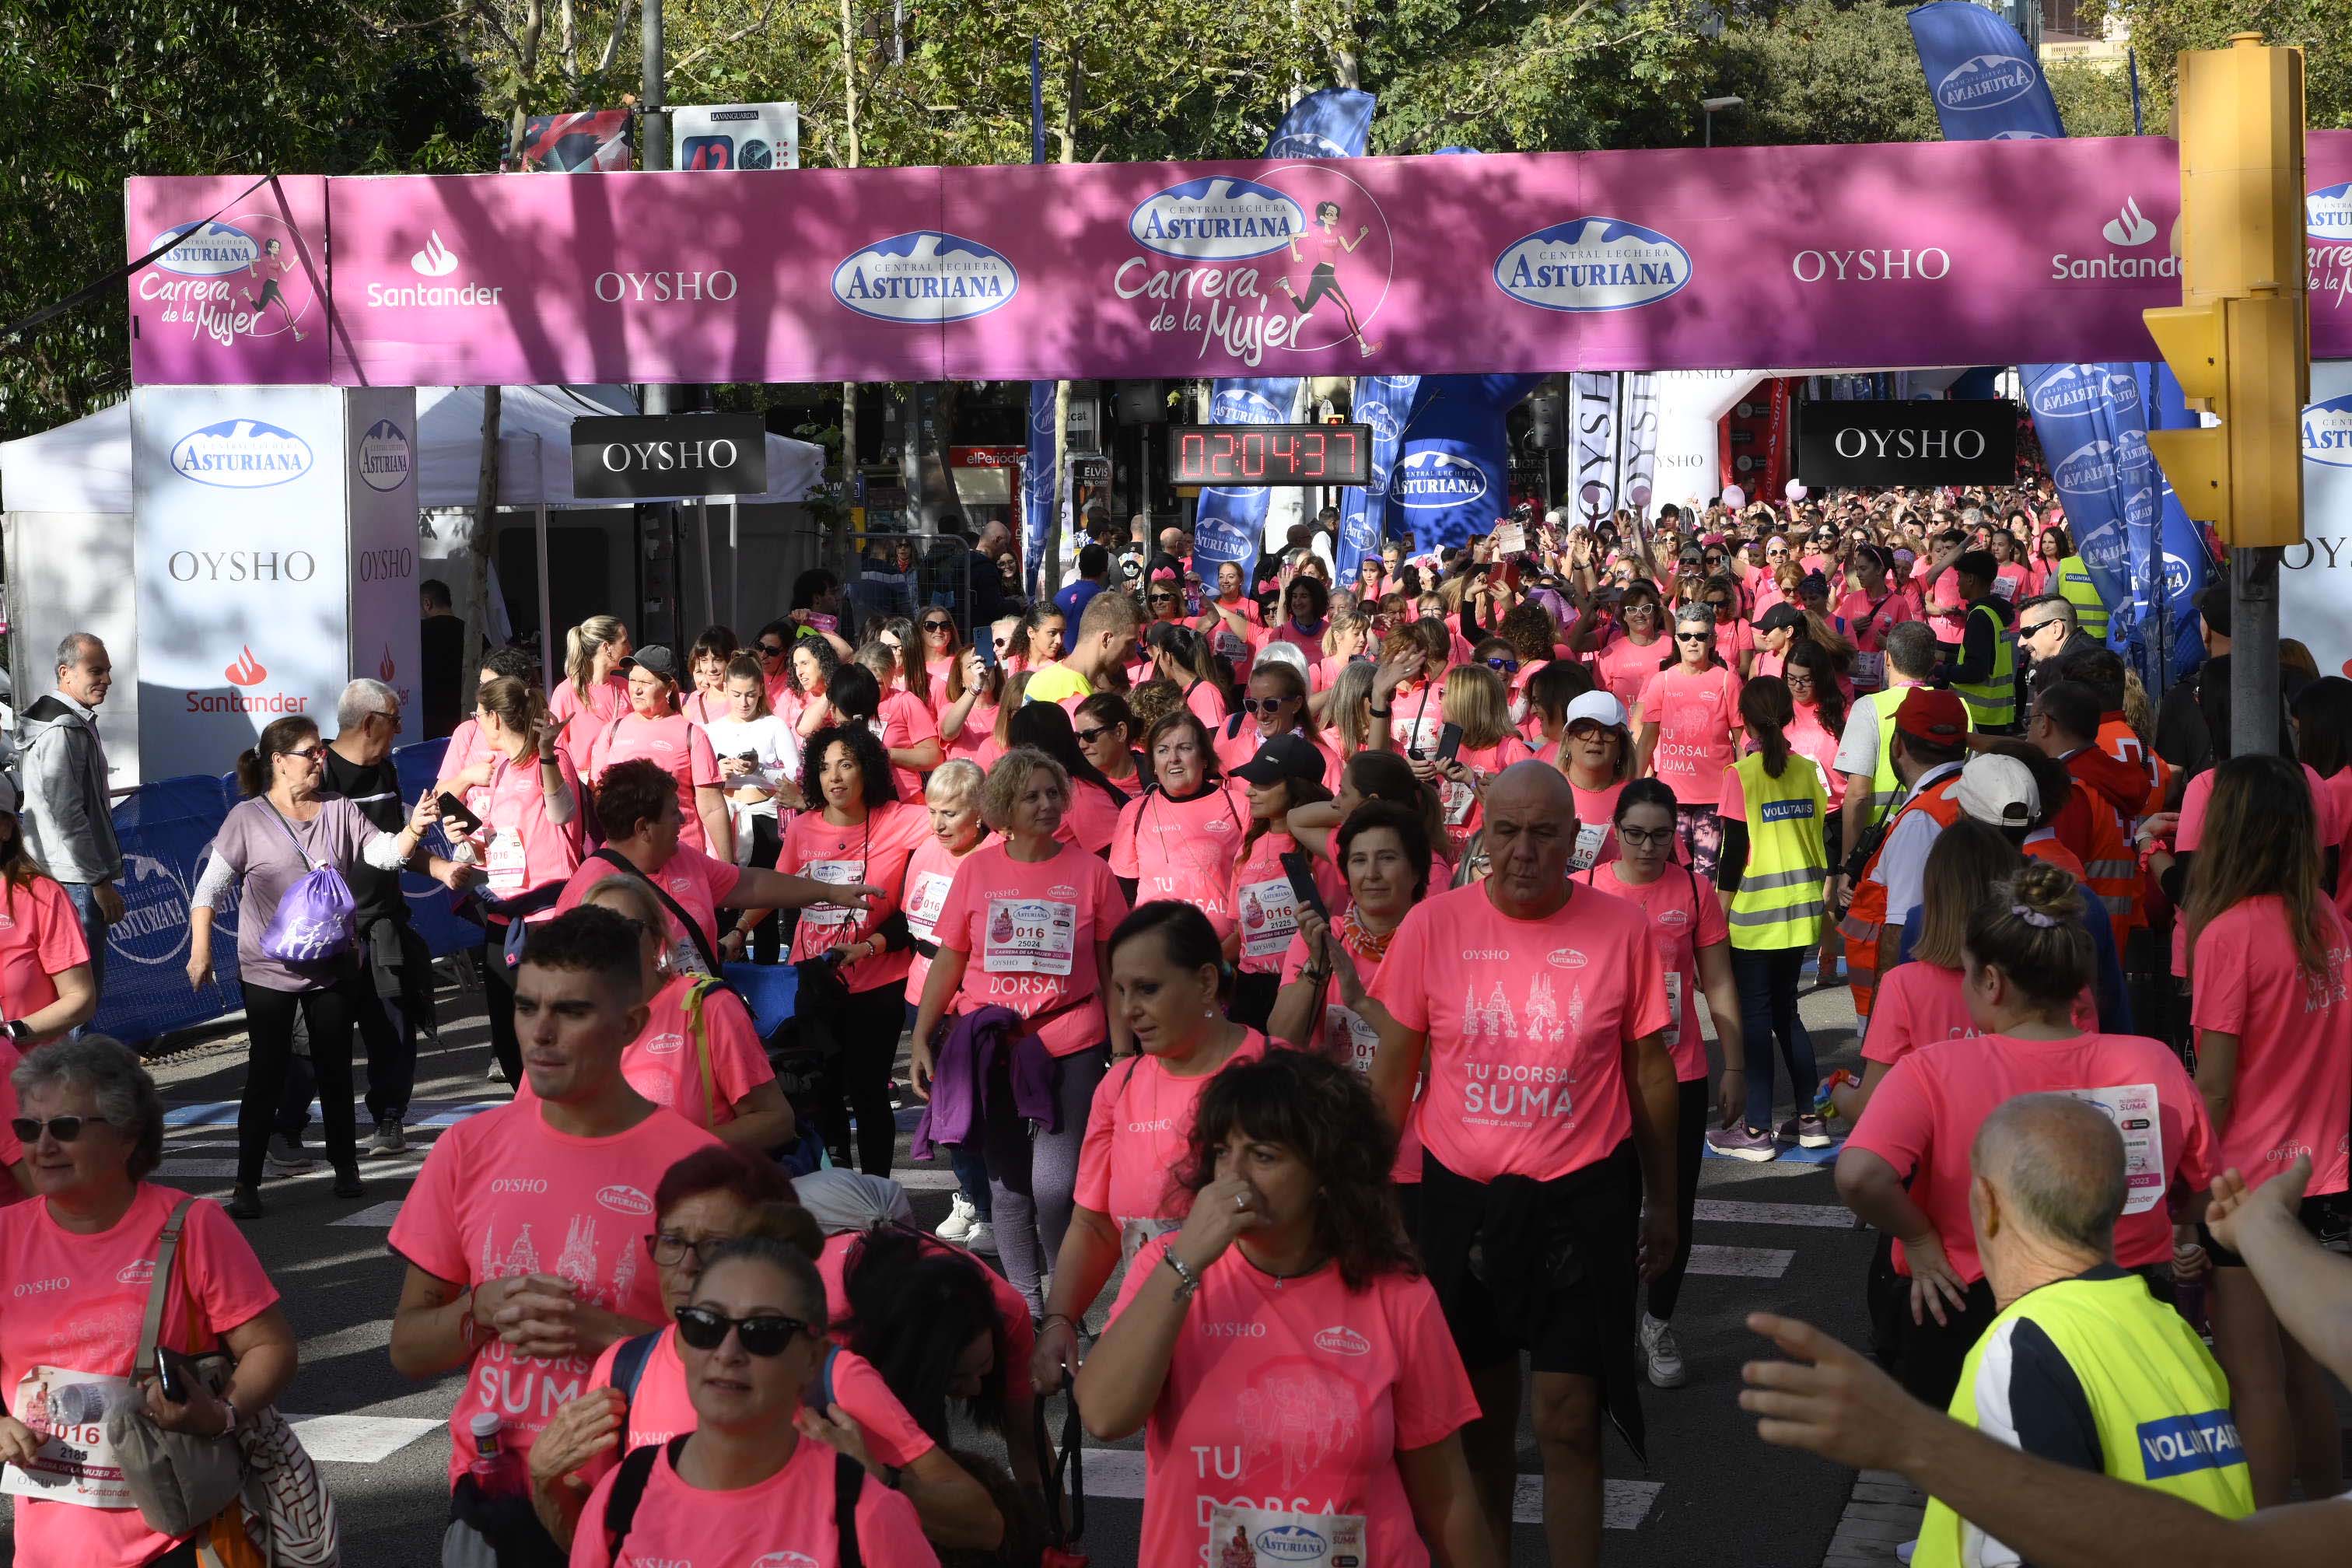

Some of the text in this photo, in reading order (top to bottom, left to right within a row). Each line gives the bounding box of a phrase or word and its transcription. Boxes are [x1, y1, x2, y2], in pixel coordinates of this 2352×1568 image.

[1170, 204, 1287, 215] CENTRAL LECHERA
[1143, 208, 1293, 240] ASTURIANA
[1539, 248, 1671, 261] CENTRAL LECHERA
[874, 262, 999, 274] CENTRAL LECHERA
[1509, 252, 1677, 289] ASTURIANA
[1792, 247, 1951, 282] OYSHO
[139, 271, 230, 302] Carrera
[594, 271, 738, 303] OYSHO
[846, 266, 1005, 300] ASTURIANA
[1114, 256, 1260, 300] Carrera
[367, 281, 502, 307] Santander
[162, 298, 266, 347] de la Mujer
[1150, 293, 1314, 368] de la Mujer
[1835, 428, 1987, 459] OYSHO
[181, 445, 303, 472] ASTURIANA
[362, 446, 408, 474] ASTURIANA
[602, 439, 738, 473] OYSHO
[1181, 433, 1355, 477] 02:04:37
[1083, 467, 1108, 478] ELVIS
[1391, 478, 1480, 496] ASTURIANA
[2280, 537, 2352, 570] OY
[168, 550, 316, 582] OYSHO
[360, 548, 411, 582] OYSHO
[186, 691, 308, 714] Santander
[1661, 727, 1673, 740] TU
[1662, 744, 1709, 758] DORSAL
[1663, 759, 1696, 772] SUMA
[1568, 858, 1588, 868] 14278
[1153, 877, 1173, 892] TU
[984, 889, 1020, 899] OYSHO
[923, 898, 940, 912] 016
[1183, 898, 1227, 915] SAL
[1265, 906, 1293, 919] 016
[1016, 926, 1045, 939] 016
[1462, 949, 1510, 961] OYSHO
[1549, 955, 1585, 965] ASTURIANA
[1038, 961, 1066, 970] Santander
[989, 976, 1069, 995] DORSAL
[1464, 1063, 1577, 1084] TU DORSAL
[1465, 1082, 1573, 1118] SUMA
[1129, 1118, 1172, 1133] OYSHO
[1462, 1116, 1490, 1126] CARRERA
[492, 1178, 548, 1195] OYSHO
[2130, 1176, 2151, 1186] 2023
[600, 1191, 649, 1213] ASTURIANA
[14, 1276, 70, 1299] OYSHO
[1201, 1322, 1266, 1338] OYSHO
[1318, 1336, 1367, 1352] ASTURIANA
[60, 1447, 88, 1461] 2185
[1190, 1445, 1241, 1479] TU
[82, 1468, 110, 1477] MUJER
[88, 1486, 131, 1497] Santander
[1262, 1535, 1323, 1554] ASTURIANA
